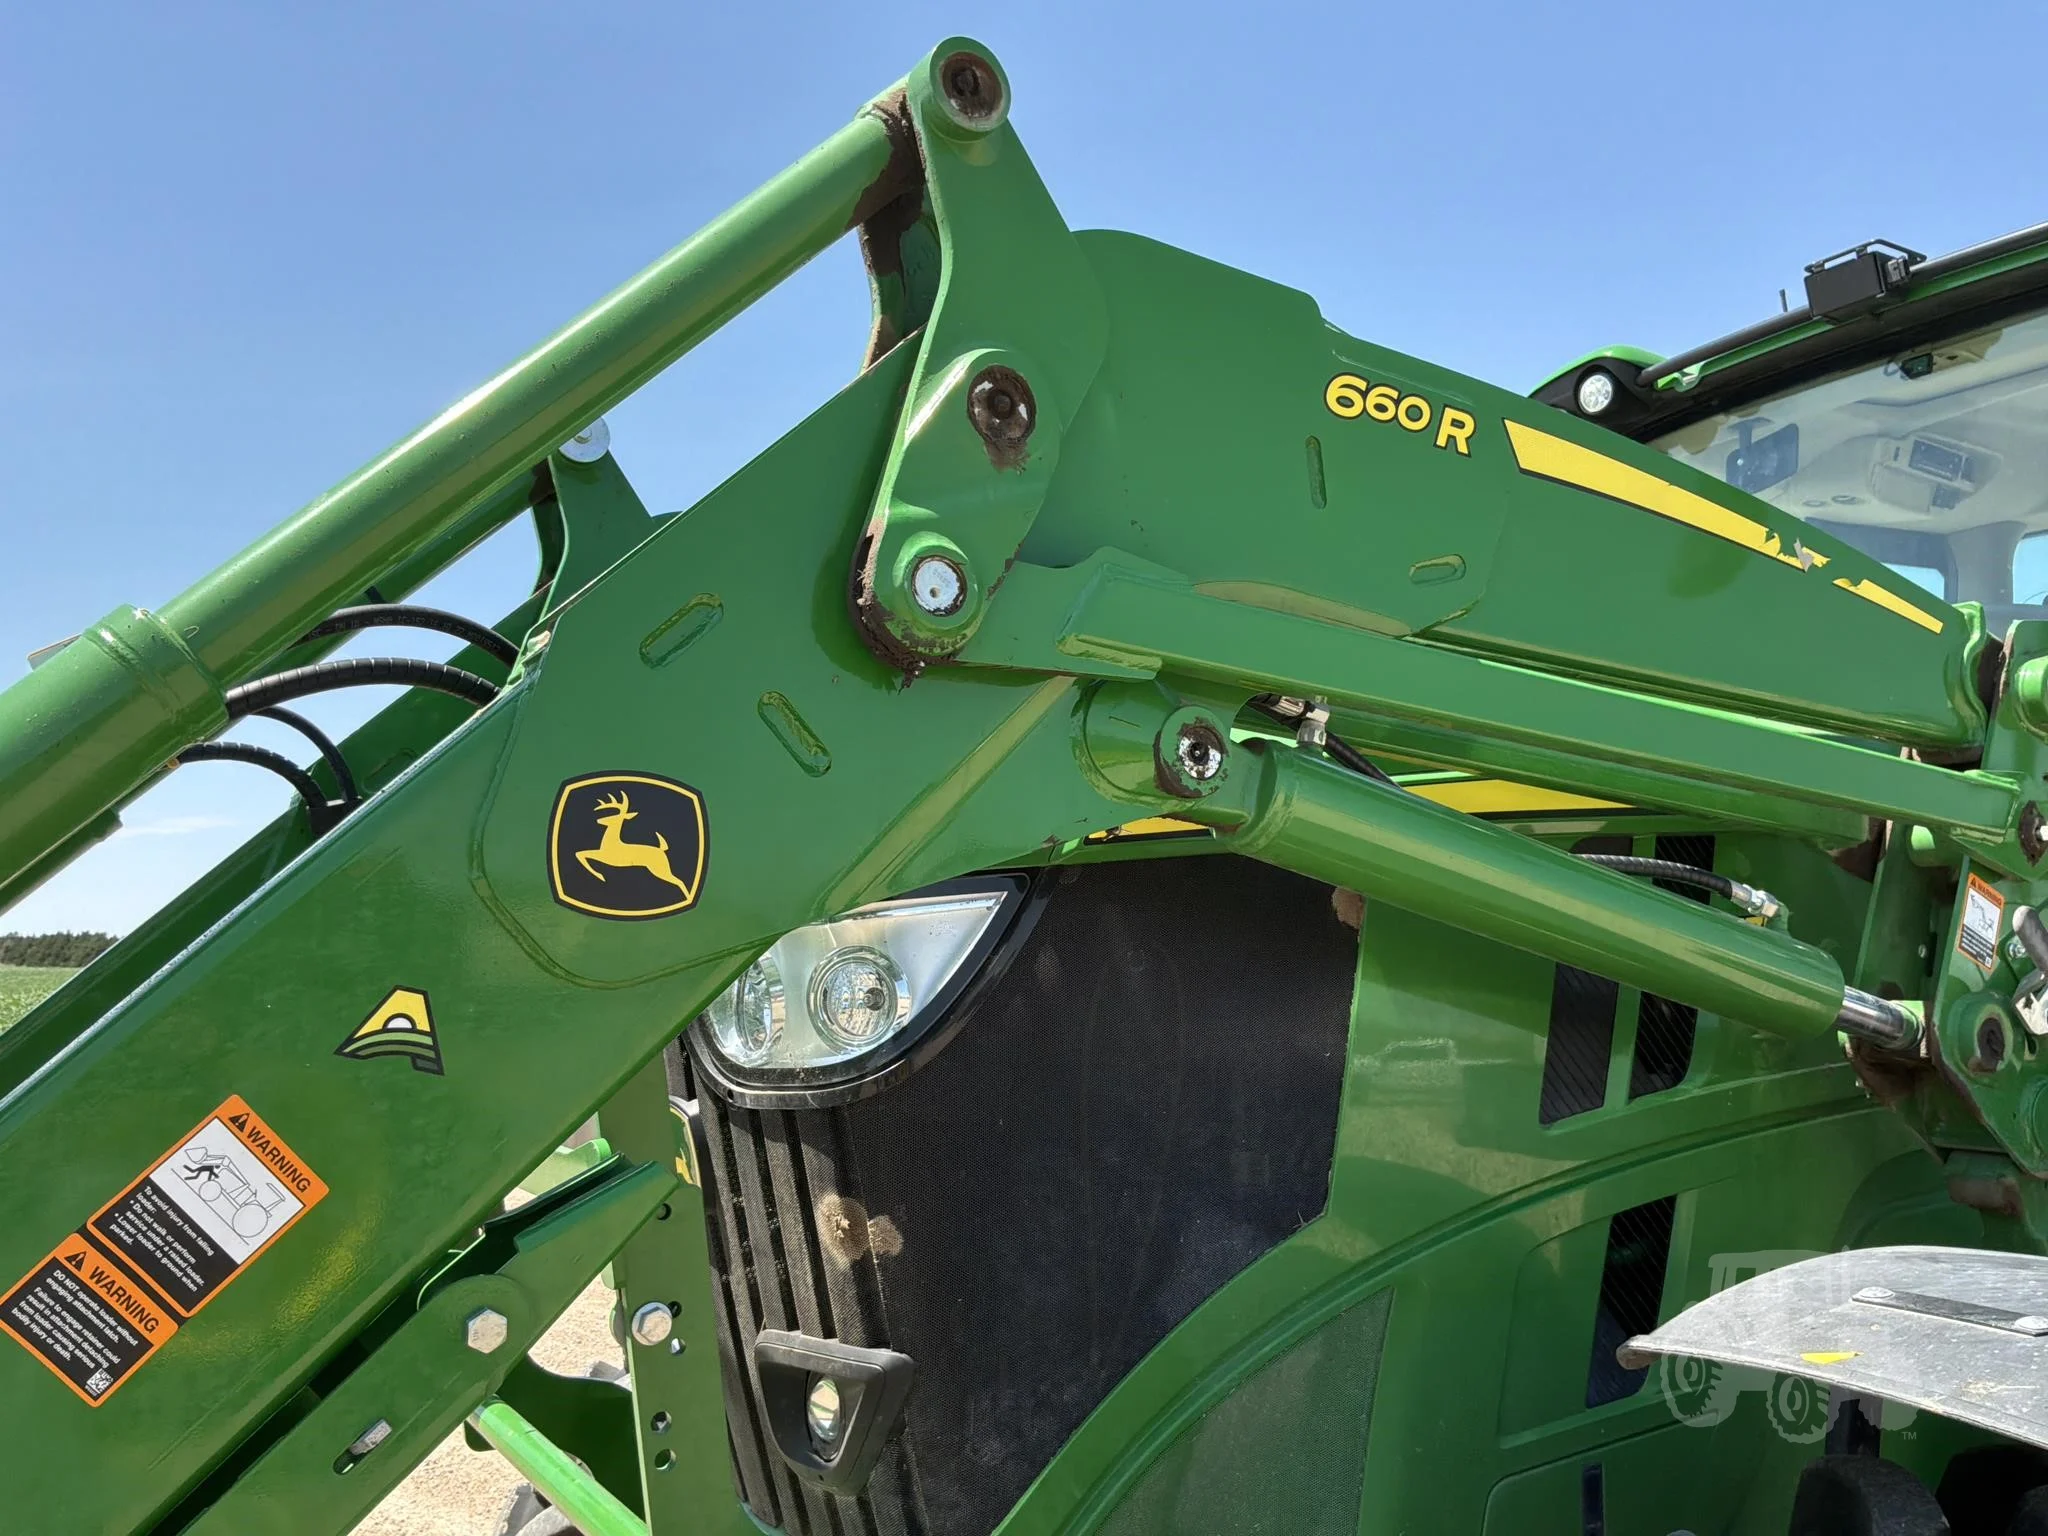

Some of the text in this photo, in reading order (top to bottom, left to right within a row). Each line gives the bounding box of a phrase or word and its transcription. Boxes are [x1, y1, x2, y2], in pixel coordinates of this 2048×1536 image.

[246, 1125, 311, 1193] WARNING
[109, 1223, 134, 1246] parked.
[135, 1192, 157, 1214] loader:
[150, 1194, 170, 1211] avoid
[166, 1208, 185, 1227] injury
[182, 1223, 198, 1240] from
[117, 1215, 138, 1235] Lower
[135, 1232, 157, 1252] loader
[160, 1257, 184, 1278] ground
[181, 1275, 198, 1292] when
[125, 1210, 148, 1232] service
[146, 1230, 166, 1247] under
[167, 1249, 189, 1269] raised
[185, 1265, 205, 1287] loader.
[141, 1212, 155, 1224] not
[152, 1221, 168, 1237] walk
[171, 1241, 197, 1265] perform
[26, 1294, 46, 1311] result
[49, 1314, 84, 1344] attachment
[80, 1341, 110, 1369] detaching
[33, 1286, 56, 1307] Failure
[60, 1310, 84, 1331] engage
[81, 1328, 105, 1350] retainer
[102, 1348, 122, 1364] could
[45, 1277, 119, 1344] engaging attachment latch.
[63, 1278, 80, 1292] NOT
[76, 1290, 101, 1312] operate
[98, 1308, 119, 1327] loader
[116, 1325, 139, 1347] without
[88, 1265, 160, 1334] WARNING
[11, 1307, 32, 1326] bodily
[29, 1322, 48, 1340] injury
[52, 1343, 71, 1361] death.
[18, 1300, 96, 1369] from loader causing serious
